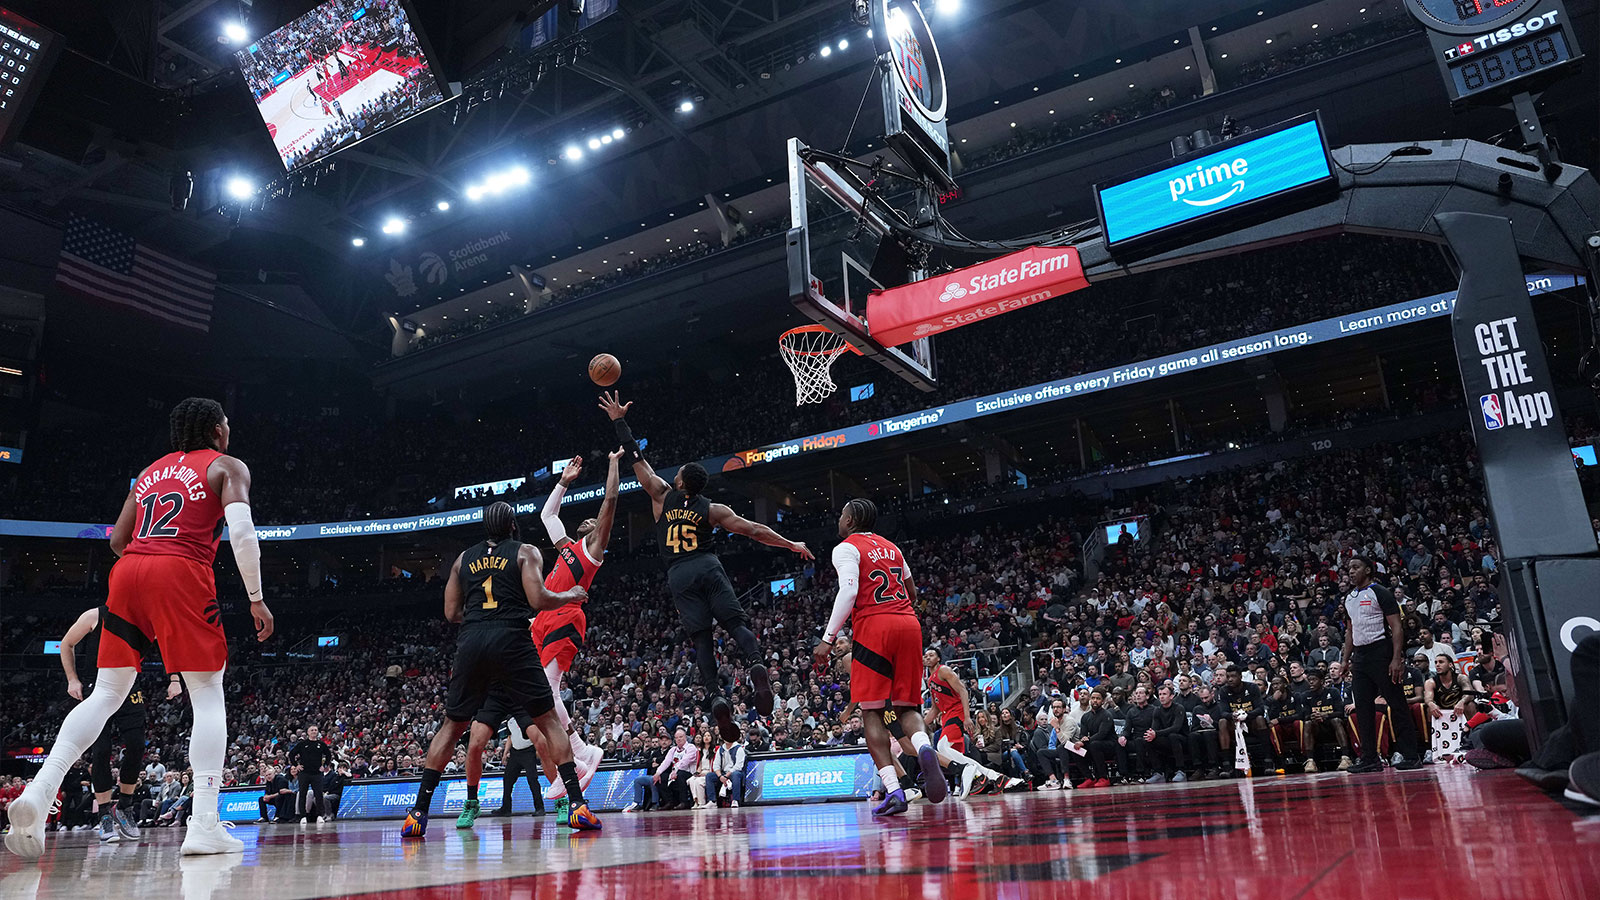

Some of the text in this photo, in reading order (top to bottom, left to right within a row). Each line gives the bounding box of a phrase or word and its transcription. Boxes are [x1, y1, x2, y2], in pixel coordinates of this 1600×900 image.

[1474, 10, 1558, 50] TISSOT
[7, 59, 15, 67] 0
[6, 89, 14, 97] 2
[1168, 158, 1248, 201] prime
[448, 230, 511, 260] Scotiabank
[454, 253, 488, 272] Arena
[1339, 314, 1383, 333] Learn
[1386, 304, 1427, 323] more
[1430, 299, 1448, 313] at
[1474, 316, 1519, 356] GET
[976, 331, 1313, 413] Exclusive offers every Friday game all season long.
[1481, 350, 1533, 390] THE
[883, 410, 939, 432] Tangerine
[1503, 390, 1554, 429] App
[746, 433, 846, 464] Fangerine Fridays
[1311, 439, 1332, 451] 120
[135, 464, 207, 503] MURRAY-BOYLES
[573, 490, 595, 502] more
[596, 486, 605, 497] at
[137, 491, 185, 539] 12
[320, 524, 362, 535] Exclusive
[364, 522, 391, 533] offers
[392, 521, 417, 531] every
[419, 515, 444, 528] Friday
[447, 513, 471, 526] game
[472, 507, 483, 520] all
[516, 501, 536, 515] long.
[665, 508, 703, 526] MITCHELL
[666, 524, 698, 554] 45
[867, 547, 895, 563] SHEAD
[468, 556, 509, 575] HARDEN
[481, 575, 498, 609] 1
[868, 566, 909, 604] 23
